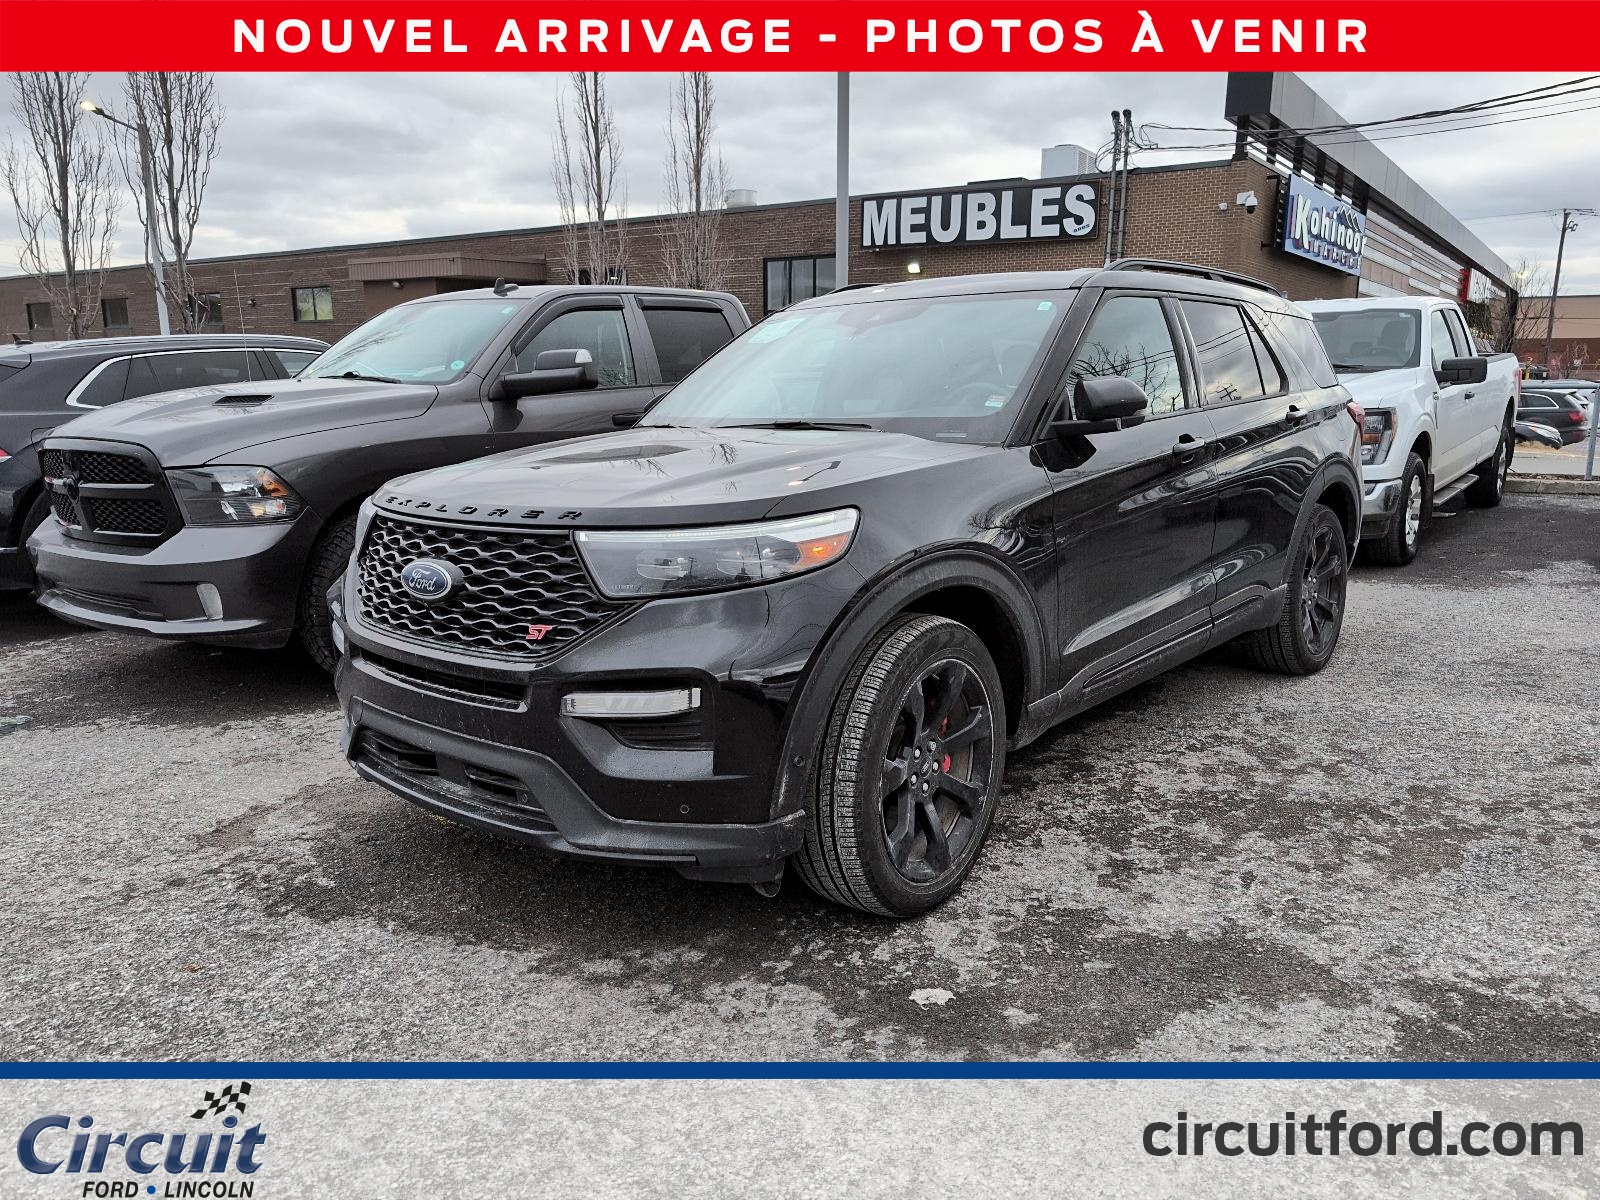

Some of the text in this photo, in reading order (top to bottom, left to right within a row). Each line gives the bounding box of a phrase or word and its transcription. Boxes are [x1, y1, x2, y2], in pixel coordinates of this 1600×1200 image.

[863, 184, 1096, 247] MEUBLES
[1294, 194, 1367, 255] Kohinoor
[385, 496, 582, 521] EXPLORER
[408, 568, 437, 591] Ford
[526, 624, 553, 640] ST
